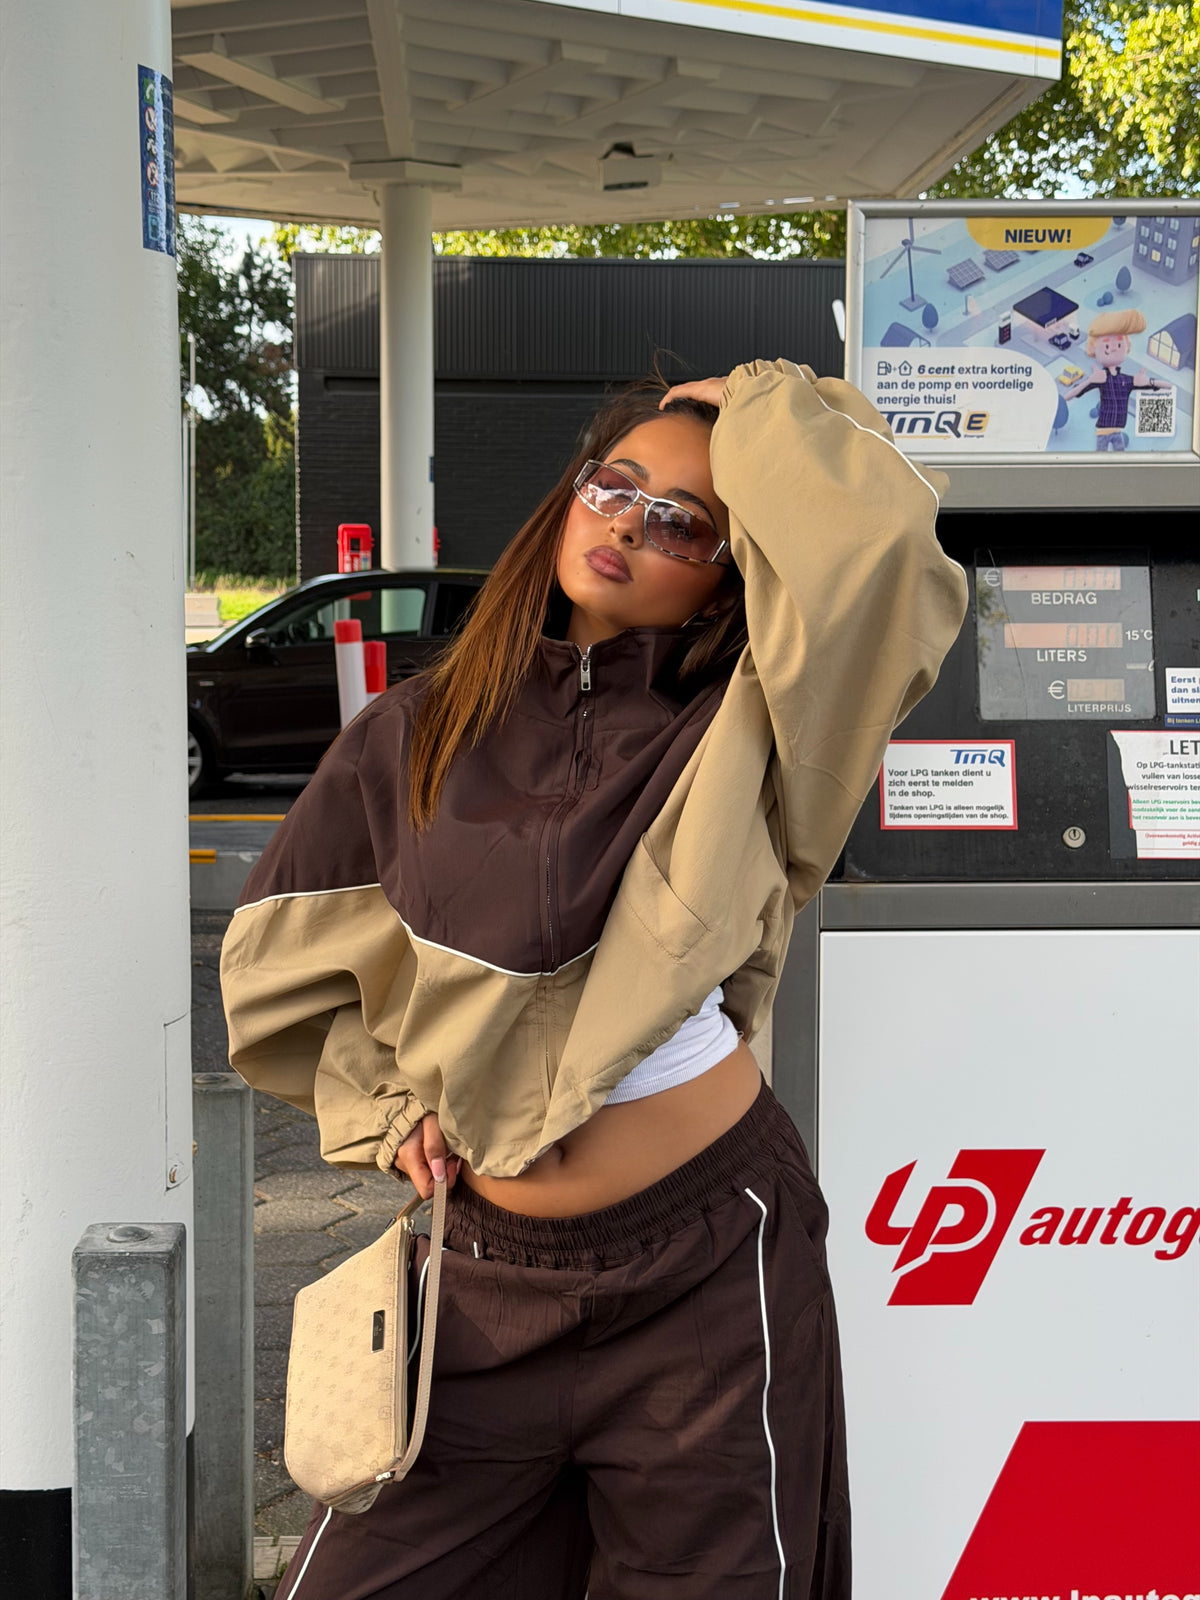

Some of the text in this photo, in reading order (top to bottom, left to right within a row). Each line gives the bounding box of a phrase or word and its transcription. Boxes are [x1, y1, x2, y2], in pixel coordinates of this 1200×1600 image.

[1005, 229, 1071, 243] NIEUW!
[917, 364, 1032, 377] 6 cent extra korting
[877, 379, 1034, 391] aan de pomp en voordelige
[877, 394, 956, 407] energie thuis!
[1031, 592, 1097, 605] BEDRAG
[1036, 650, 1088, 662] LITERS
[1171, 676, 1196, 684] Eerst
[1048, 680, 1065, 700] €
[1171, 686, 1189, 694] dan
[1067, 703, 1132, 713] LITERPRIJS
[1169, 739, 1200, 756] LET
[950, 749, 1006, 767] TinQ
[1136, 761, 1147, 770] Op
[888, 769, 908, 777] Voor
[910, 769, 929, 777] LPG
[931, 769, 960, 777] tanken
[962, 769, 983, 777] dient
[1141, 772, 1165, 780] vullen
[888, 779, 974, 787] zich eerst te melden
[888, 789, 936, 799] in de shop.
[975, 804, 1005, 812] mogelijk
[1019, 1197, 1200, 1261] autog
